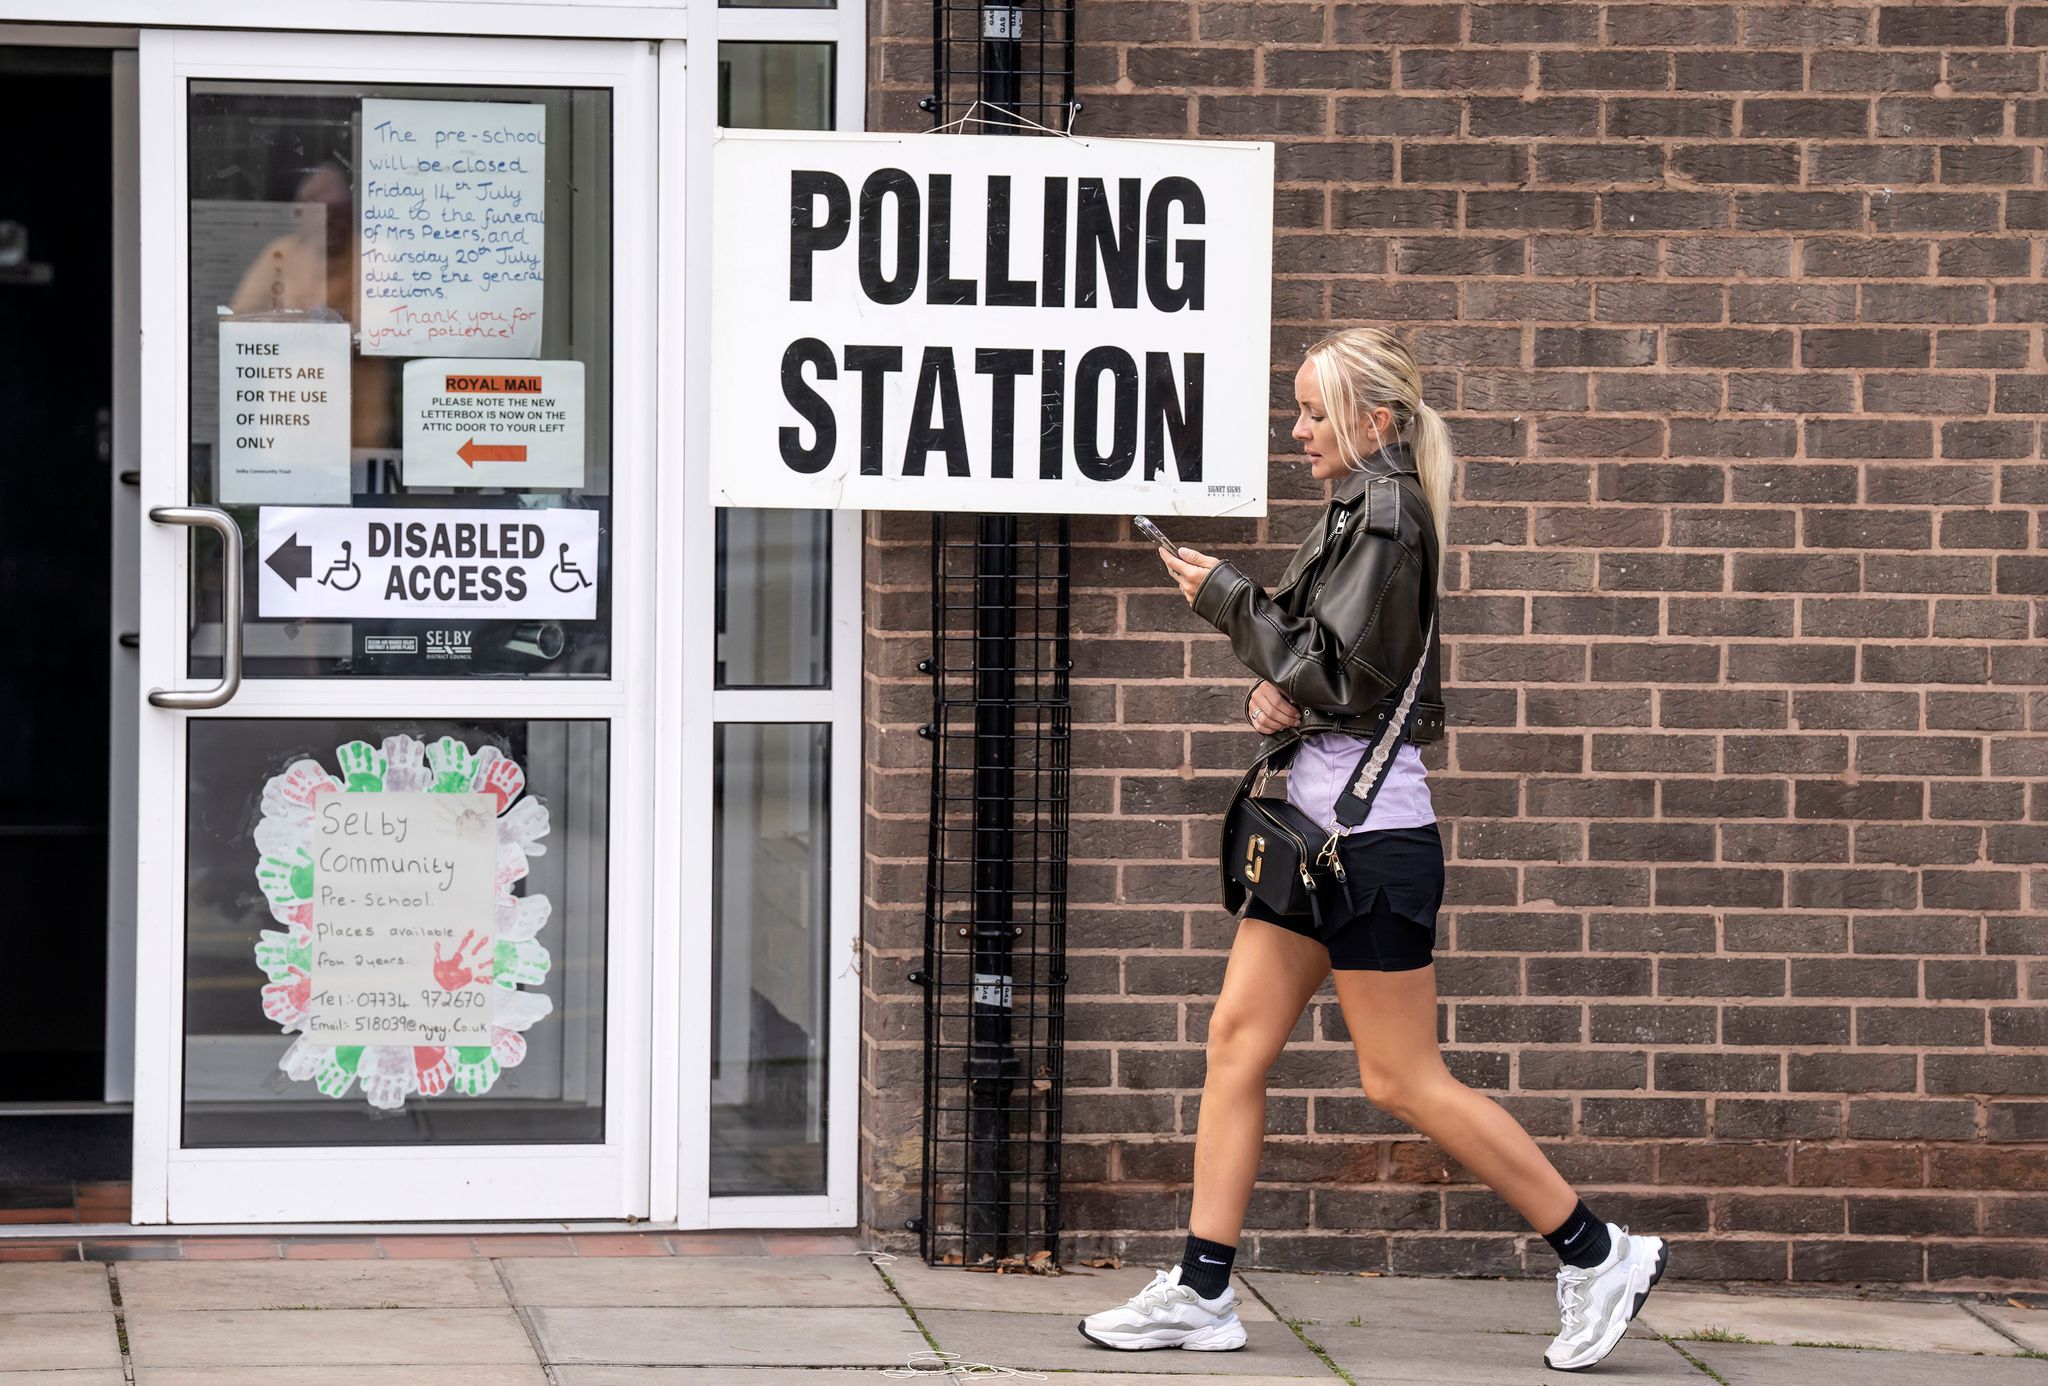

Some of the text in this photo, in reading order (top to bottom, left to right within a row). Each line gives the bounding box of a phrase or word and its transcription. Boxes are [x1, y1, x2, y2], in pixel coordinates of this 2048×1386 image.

[374, 121, 416, 143] The
[369, 156, 527, 173] will be closed
[368, 181, 522, 210] Friday 14th July
[365, 205, 544, 229] due to the funeral
[364, 224, 381, 243] of
[387, 227, 415, 241] Mrs
[488, 228, 528, 244] and
[789, 167, 1206, 313] POLLING
[362, 246, 541, 271] Thursday 20th July
[366, 268, 544, 292] due to the general
[366, 287, 447, 299] elections.
[390, 305, 536, 331] Thank you for
[369, 327, 412, 347] your
[236, 344, 279, 355] THESE
[236, 367, 324, 379] TOILETS ARE
[446, 378, 541, 391] ROYAL MAIL
[237, 390, 327, 403] FOR THE USE
[432, 397, 555, 407] PLEASE NOTE THE NEW
[421, 410, 566, 420] LETTERBOX IS NOW ON THE
[778, 337, 1205, 482] STATION
[236, 413, 310, 426] OF HIRERS
[422, 423, 565, 432] ATTIC DOOR TO YOUR LEFT
[236, 437, 275, 449] ONLY
[367, 522, 545, 559] DISABLED
[384, 565, 528, 601] ACCESS
[426, 631, 472, 645] SELBY
[321, 801, 407, 842] Selby
[319, 847, 454, 891] Community
[389, 927, 454, 937] available
[421, 990, 485, 1007] 972670
